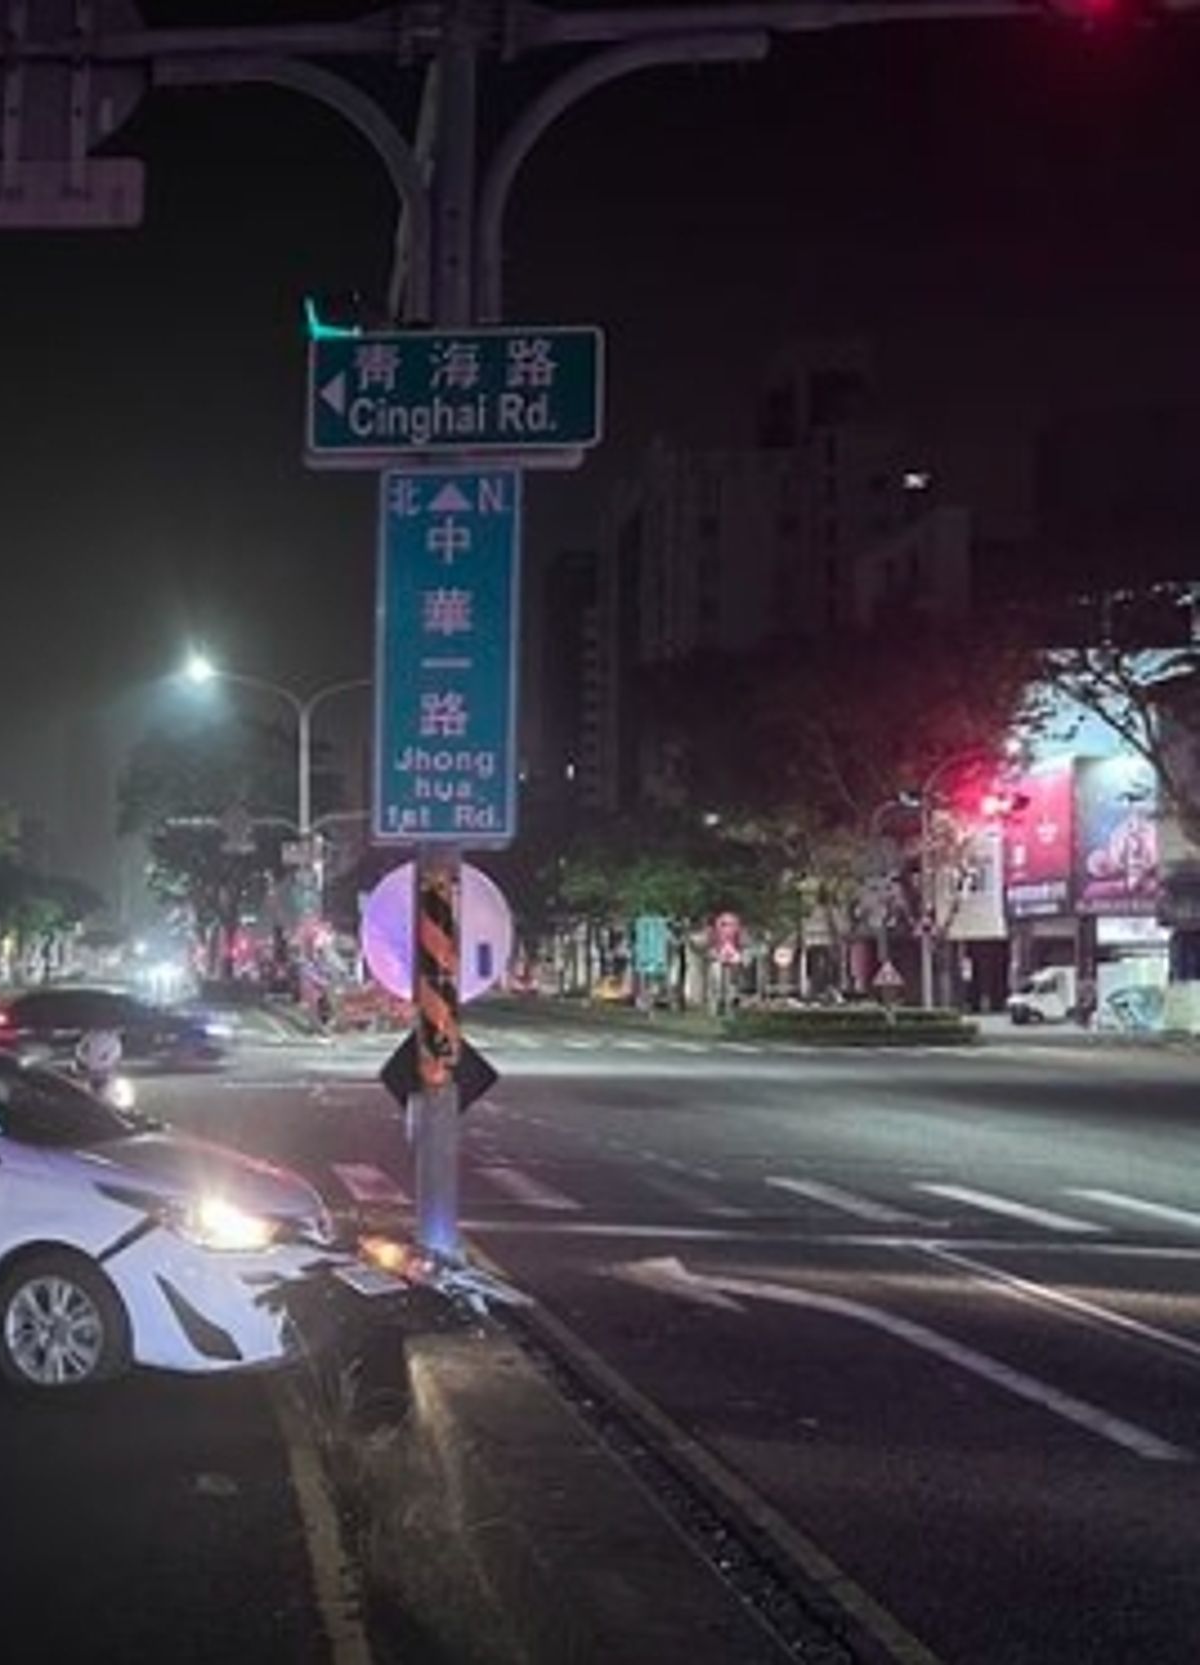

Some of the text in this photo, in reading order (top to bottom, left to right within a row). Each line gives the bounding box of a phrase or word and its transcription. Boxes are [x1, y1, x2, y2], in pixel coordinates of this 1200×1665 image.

[355, 339, 557, 391] 青海路
[349, 392, 557, 444] Cinghai Rd.
[389, 479, 421, 514] 北
[477, 478, 504, 512] N
[419, 516, 473, 736] 中華一路
[393, 746, 494, 779] Jhong
